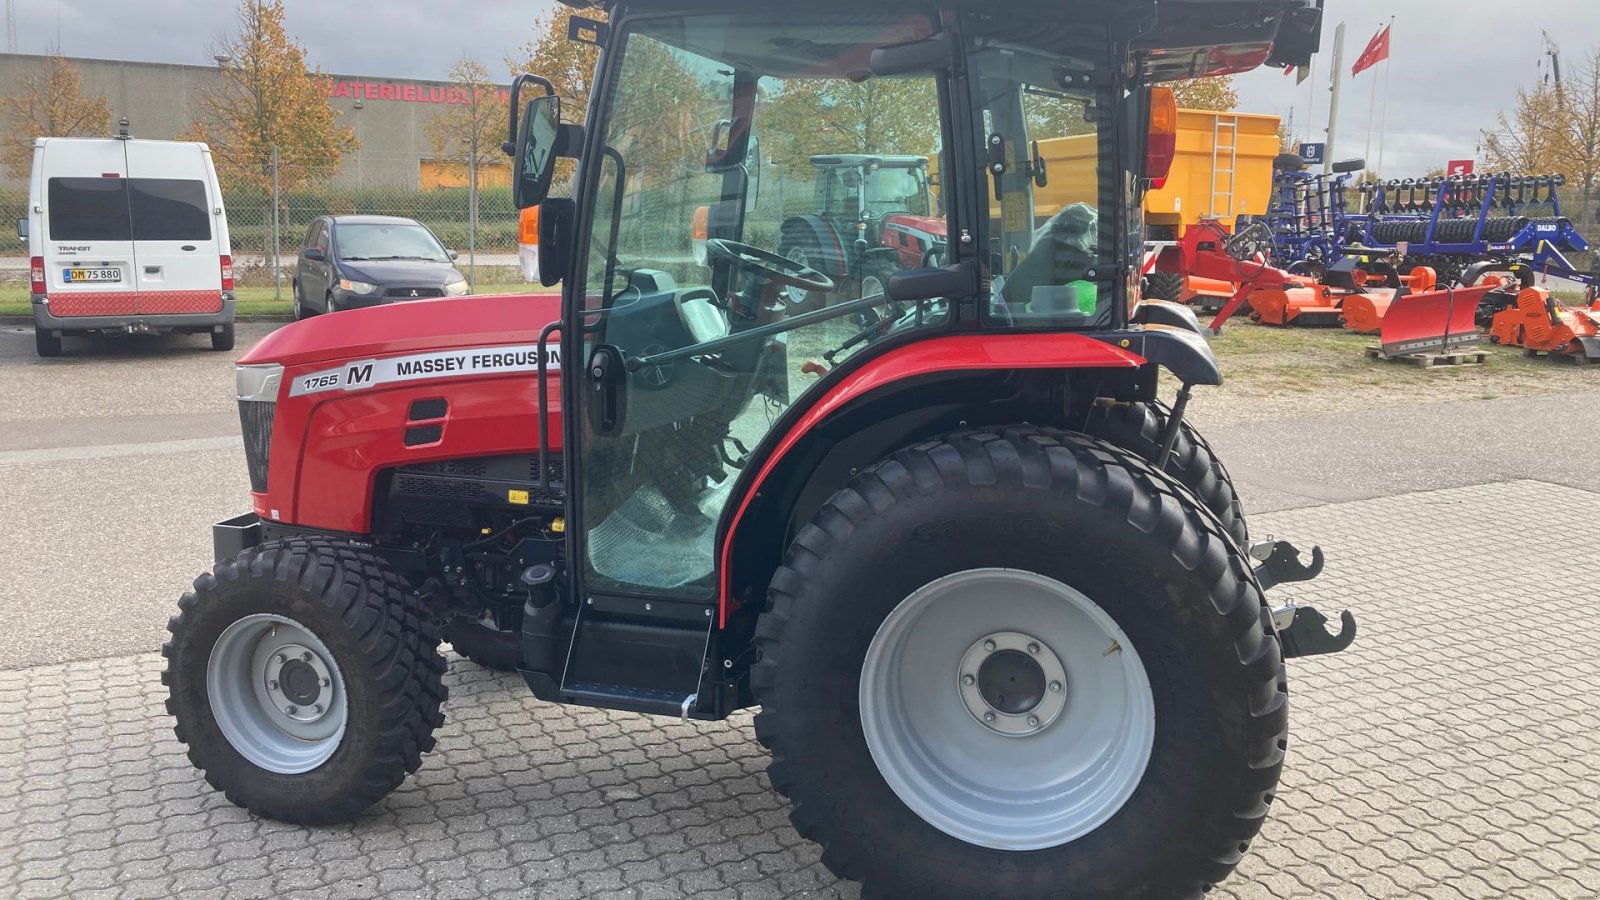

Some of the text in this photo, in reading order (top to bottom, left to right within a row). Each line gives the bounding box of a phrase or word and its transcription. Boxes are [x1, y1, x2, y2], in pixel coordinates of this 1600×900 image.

[71, 270, 119, 279] DM 75 880
[397, 350, 560, 376] MASSEY FERGUSN
[304, 364, 373, 389] 1765 M
